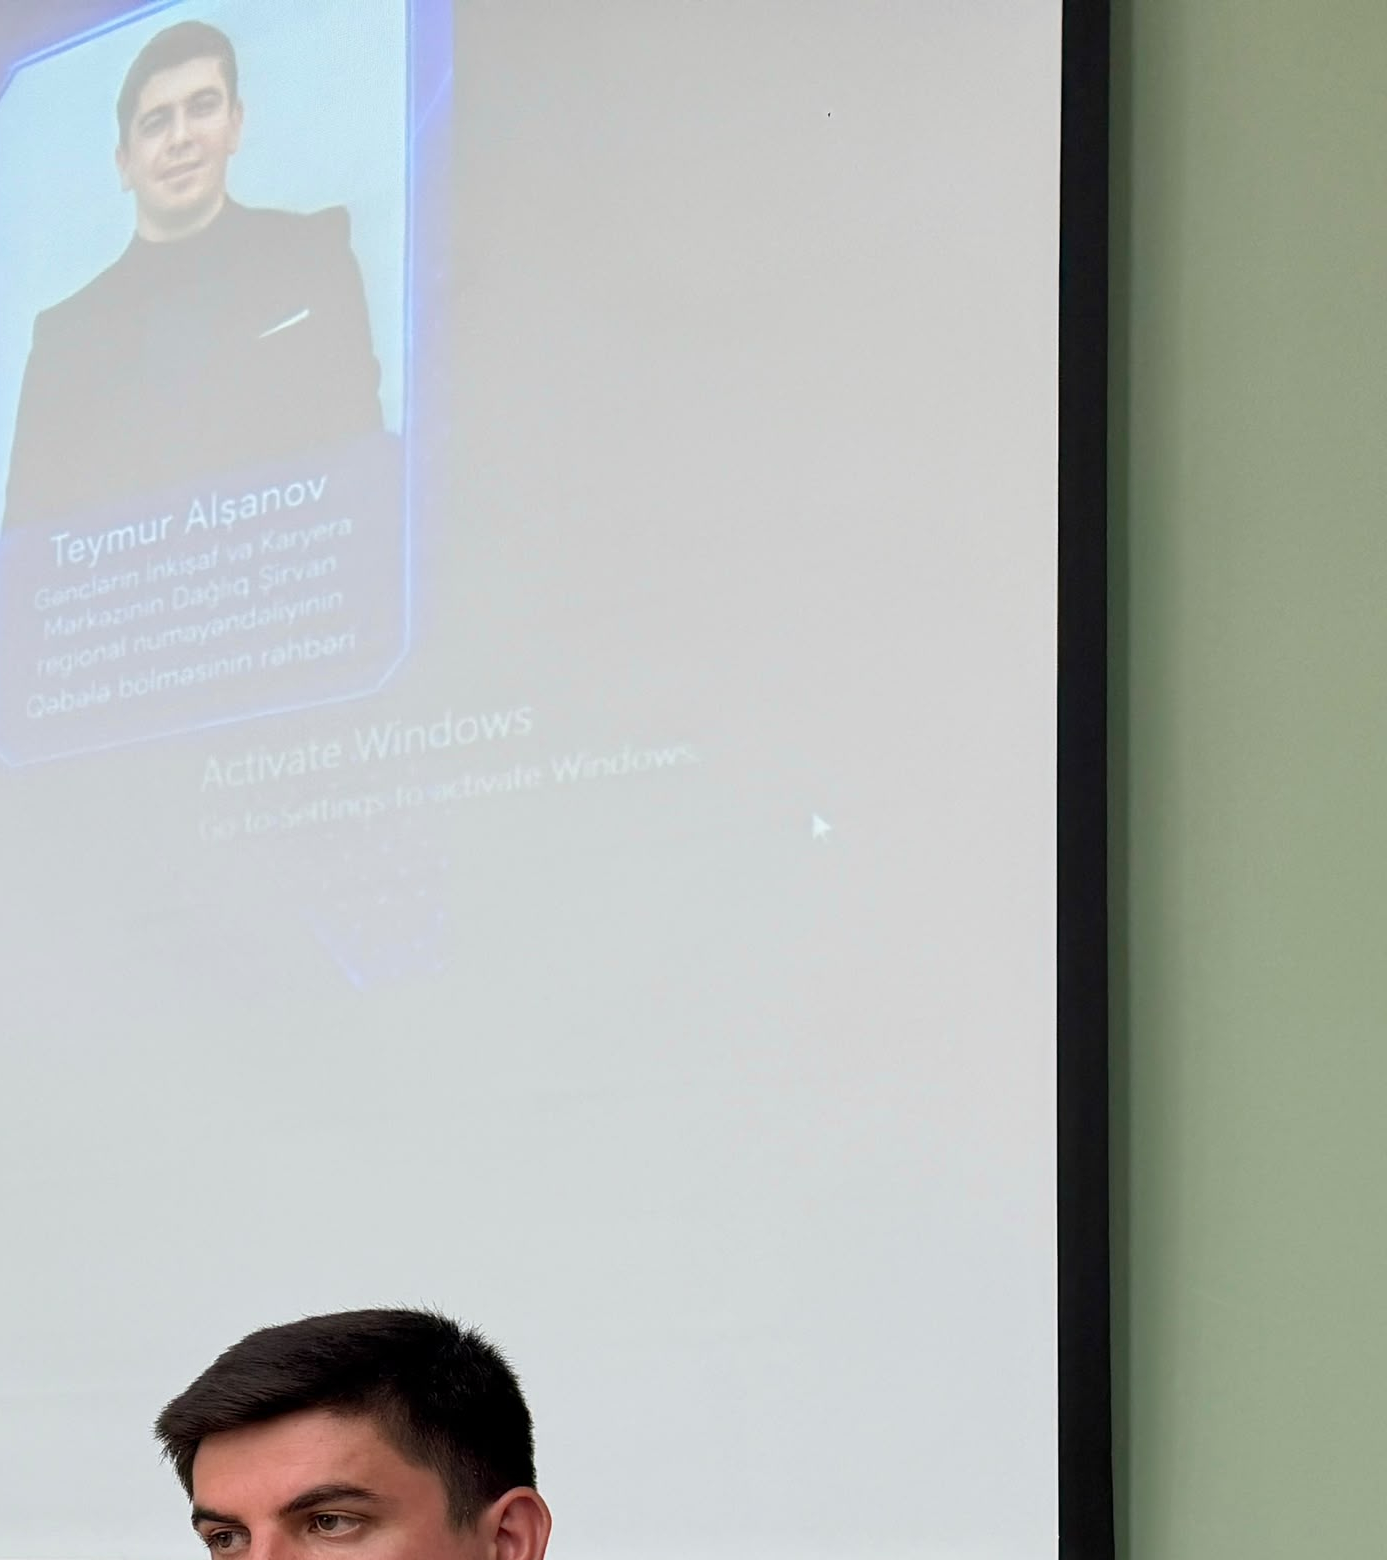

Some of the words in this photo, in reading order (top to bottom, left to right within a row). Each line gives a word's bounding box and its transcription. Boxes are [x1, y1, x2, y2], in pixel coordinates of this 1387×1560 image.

[49, 512, 174, 568] Teymur
[184, 473, 329, 533] Alşanov
[37, 637, 127, 679] regional
[200, 738, 343, 792] Activate
[354, 706, 534, 762] Windows
